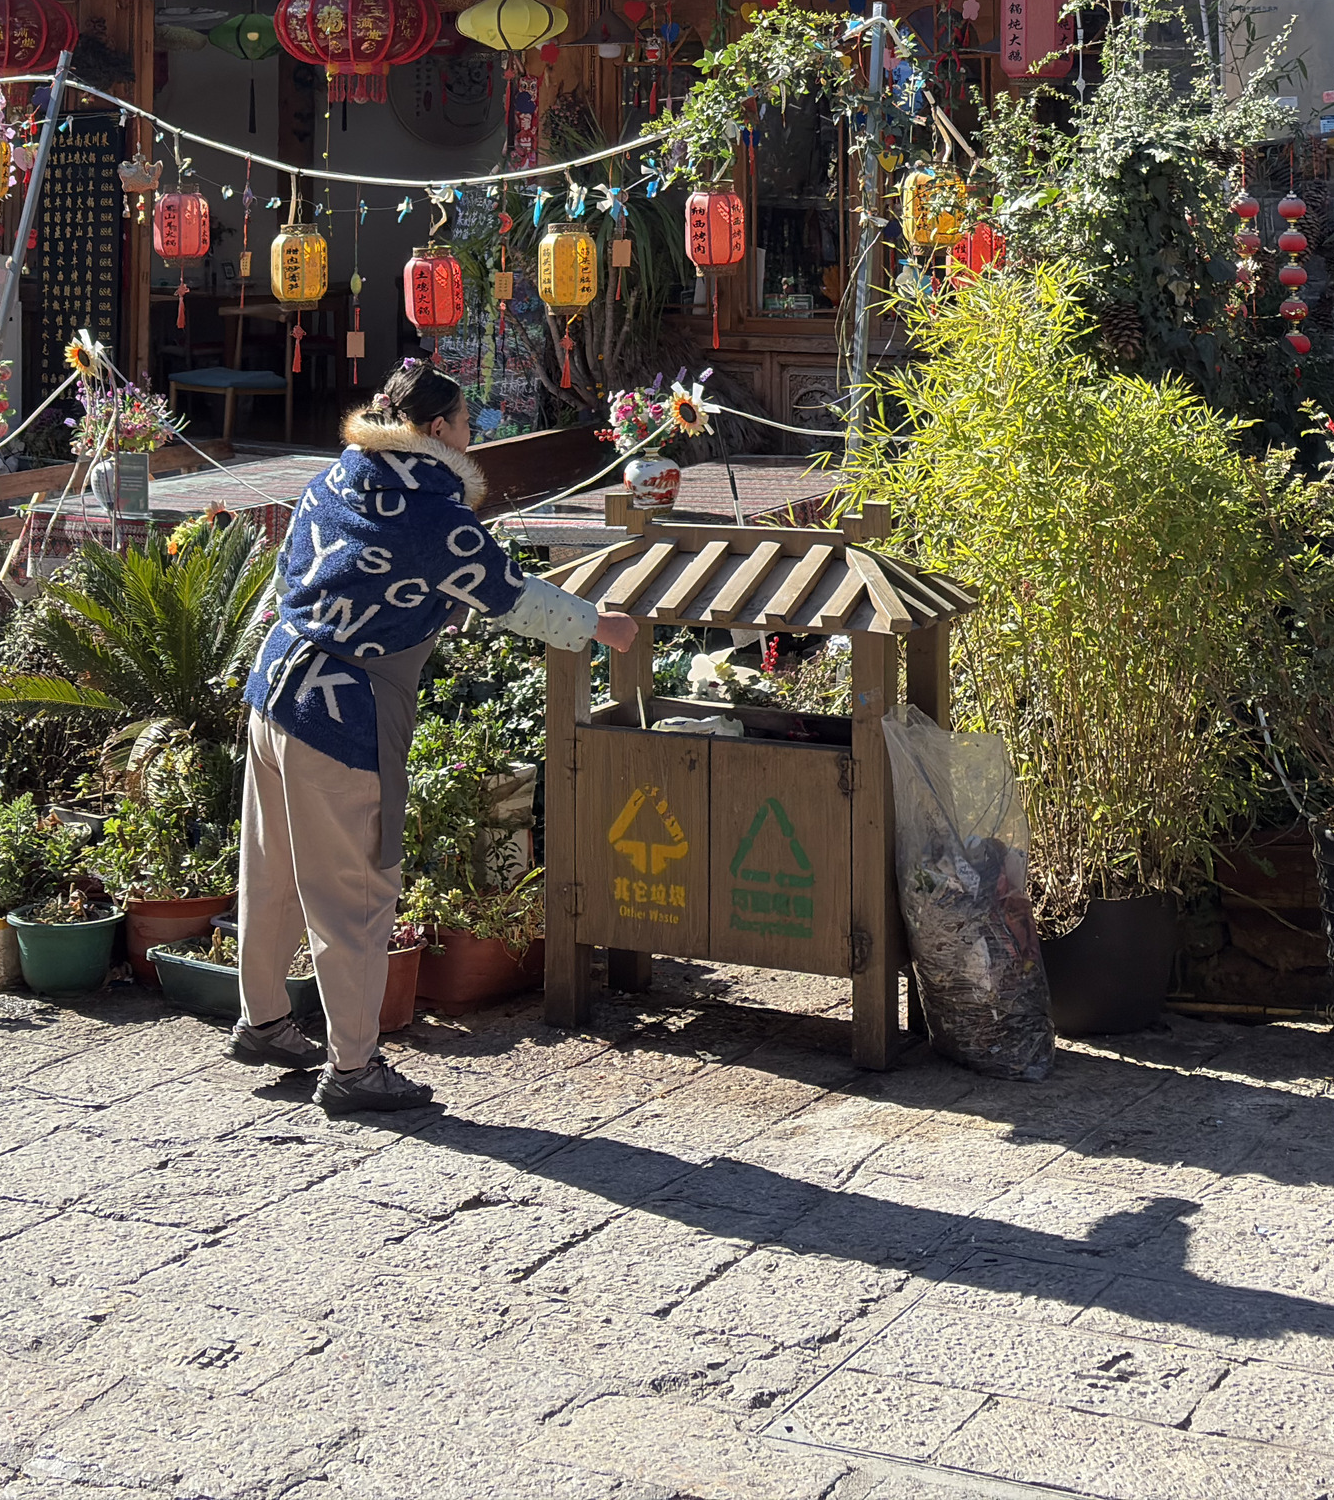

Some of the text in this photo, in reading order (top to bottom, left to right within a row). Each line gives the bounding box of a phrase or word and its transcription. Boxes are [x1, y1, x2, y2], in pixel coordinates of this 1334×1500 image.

[691, 206, 706, 254] 纳西烤肉
[357, 546, 393, 574] S
[384, 578, 430, 608] G
[614, 876, 685, 908] 其它垃圾
